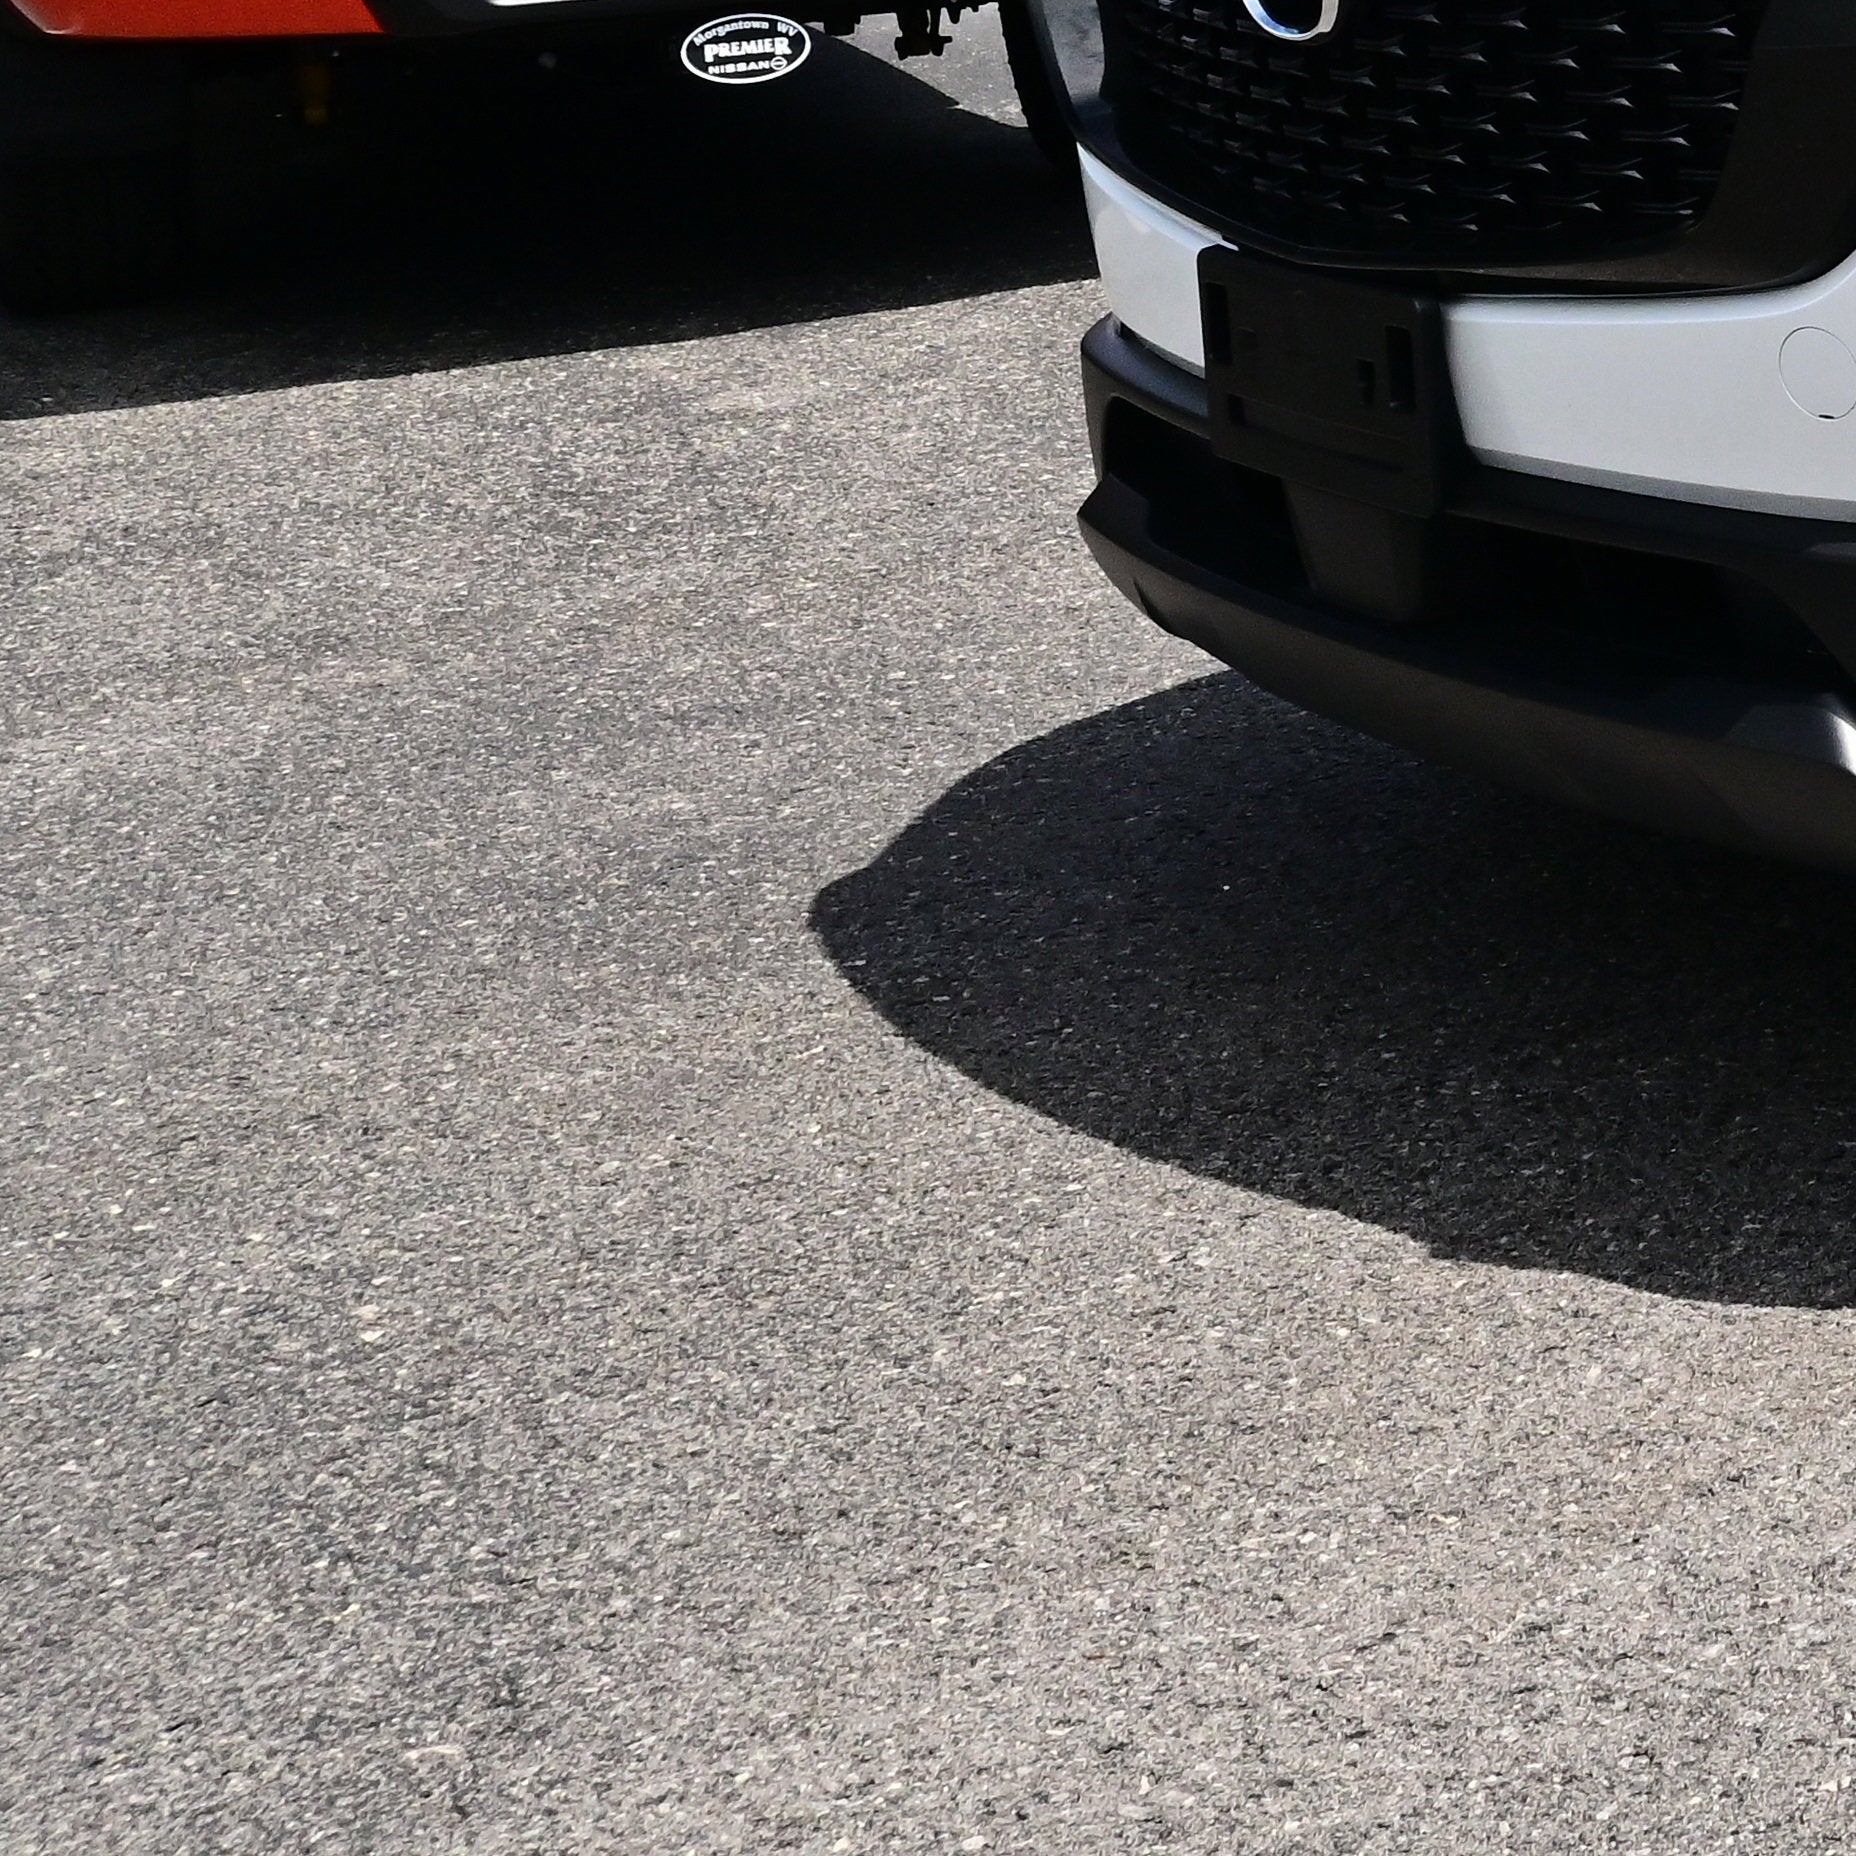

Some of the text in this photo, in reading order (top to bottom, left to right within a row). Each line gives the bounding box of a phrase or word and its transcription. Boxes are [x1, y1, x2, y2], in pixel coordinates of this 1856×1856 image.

[693, 20, 799, 46] Morgantown WV
[703, 36, 793, 62] PREMIER
[708, 60, 770, 75] NISSAN
